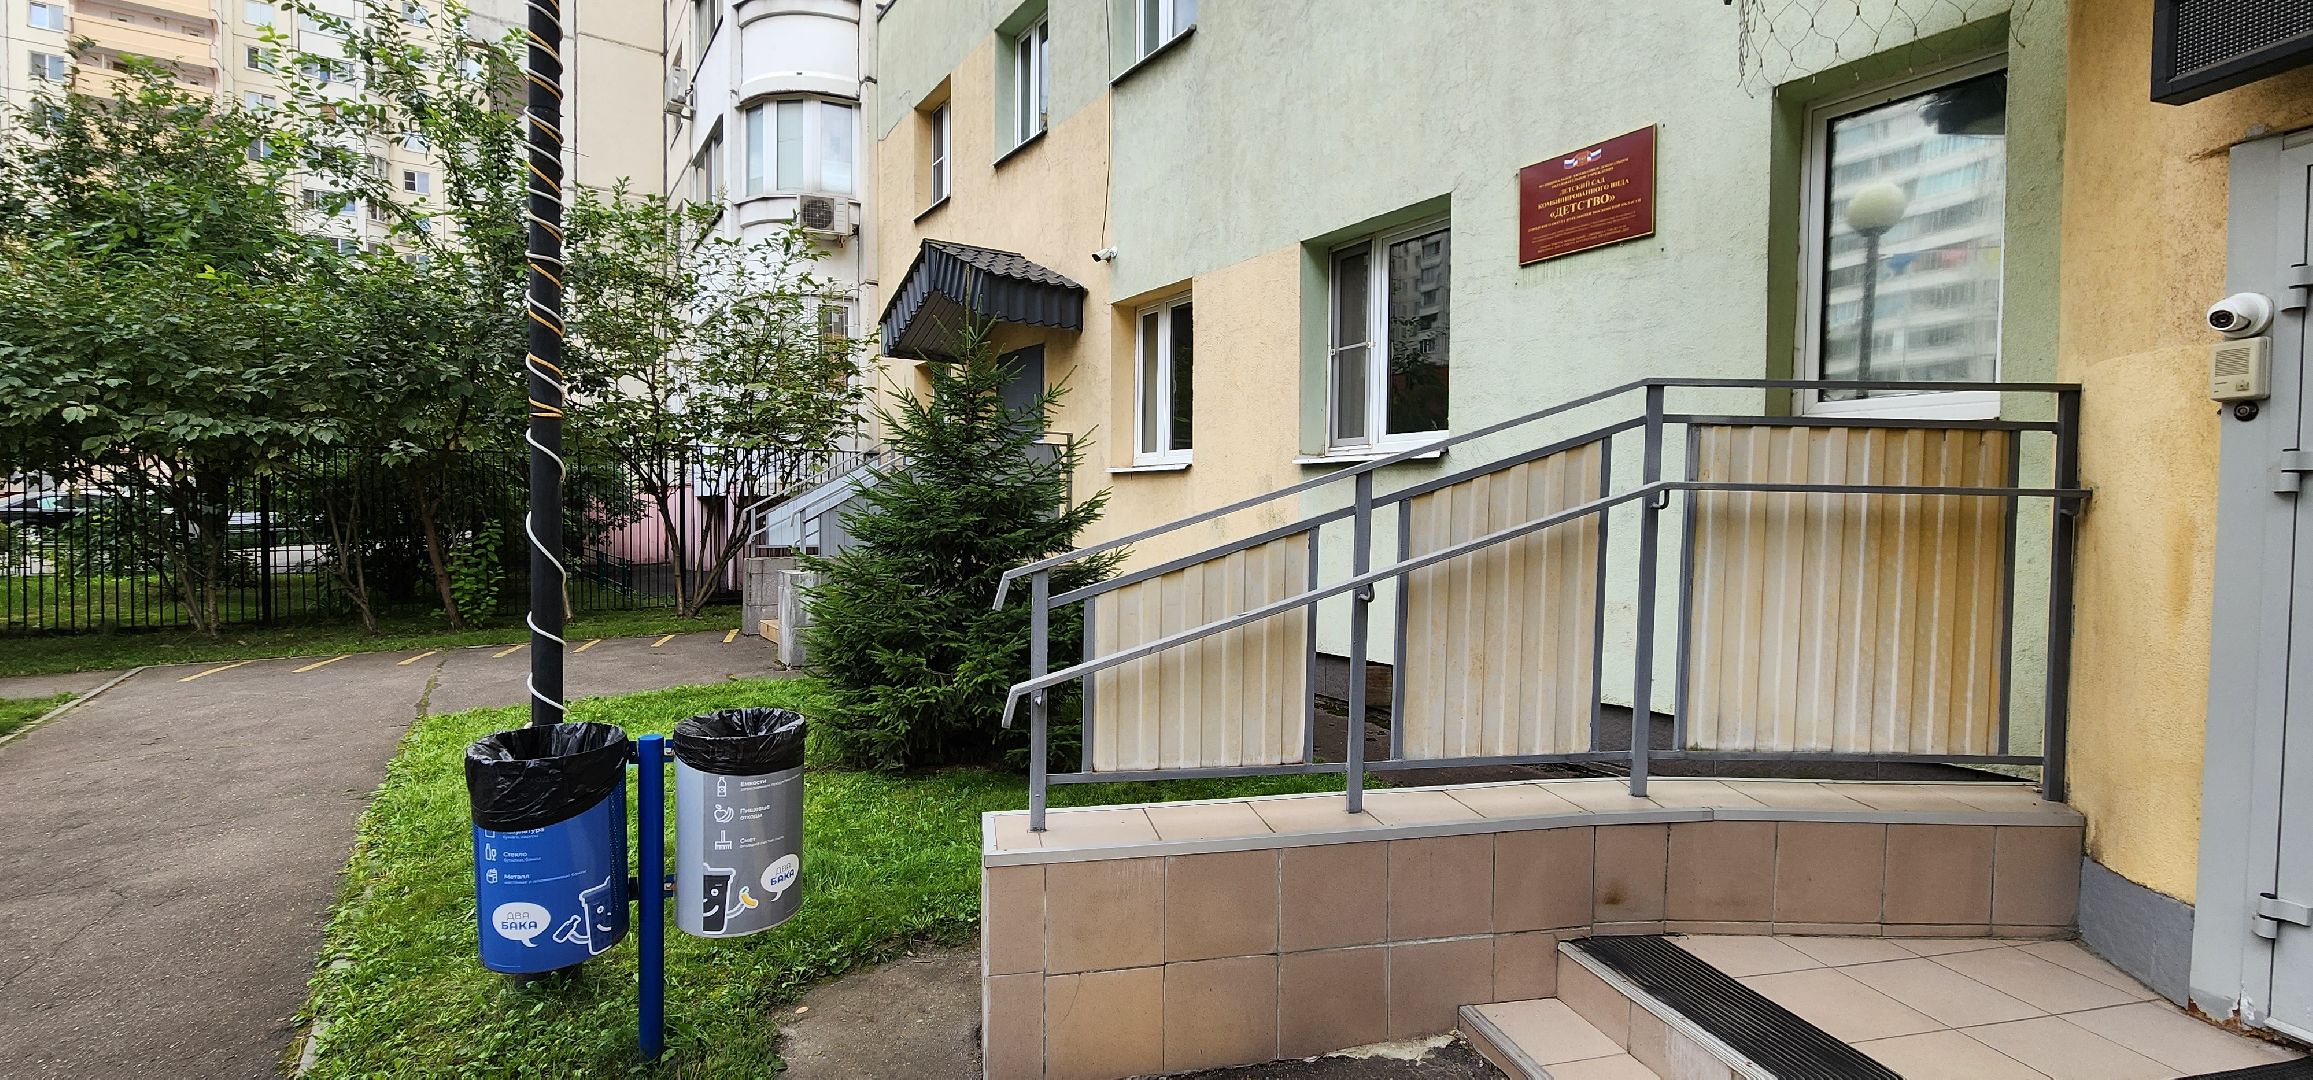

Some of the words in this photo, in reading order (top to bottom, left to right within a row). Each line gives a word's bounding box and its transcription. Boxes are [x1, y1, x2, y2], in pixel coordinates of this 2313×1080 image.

[1549, 193, 1616, 219] «ДЕТСТВО»
[776, 862, 792, 875] ДВА
[770, 868, 795, 886] БАКА
[506, 911, 530, 921] ДВА
[501, 920, 538, 931] БАКА
